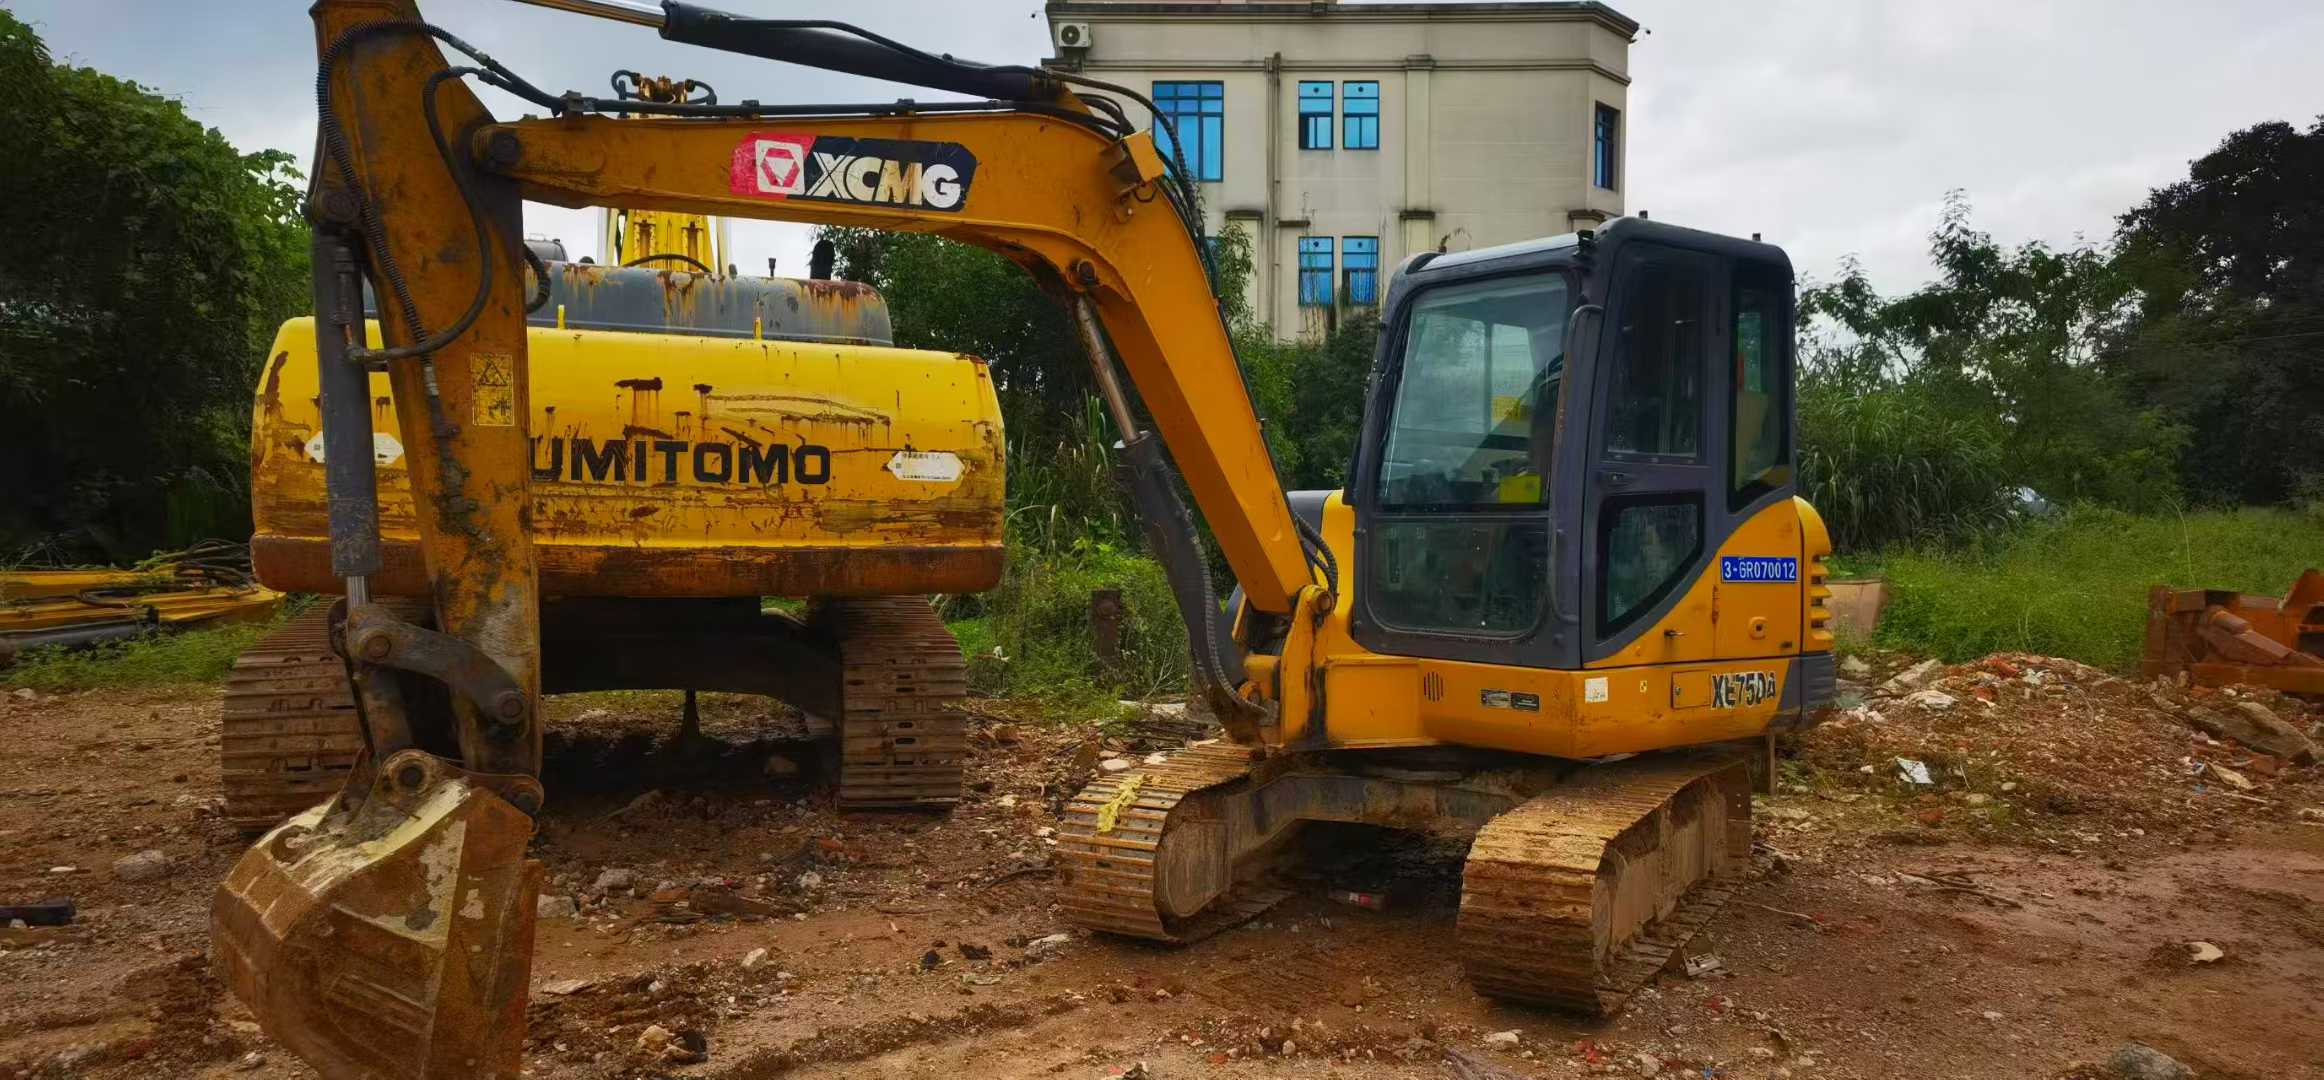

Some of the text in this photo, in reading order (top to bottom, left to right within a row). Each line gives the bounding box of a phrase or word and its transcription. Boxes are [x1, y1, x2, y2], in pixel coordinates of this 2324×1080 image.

[805, 151, 961, 209] XCMG
[529, 437, 831, 485] UMITOMO
[1724, 561, 1796, 579] 3-GR070012
